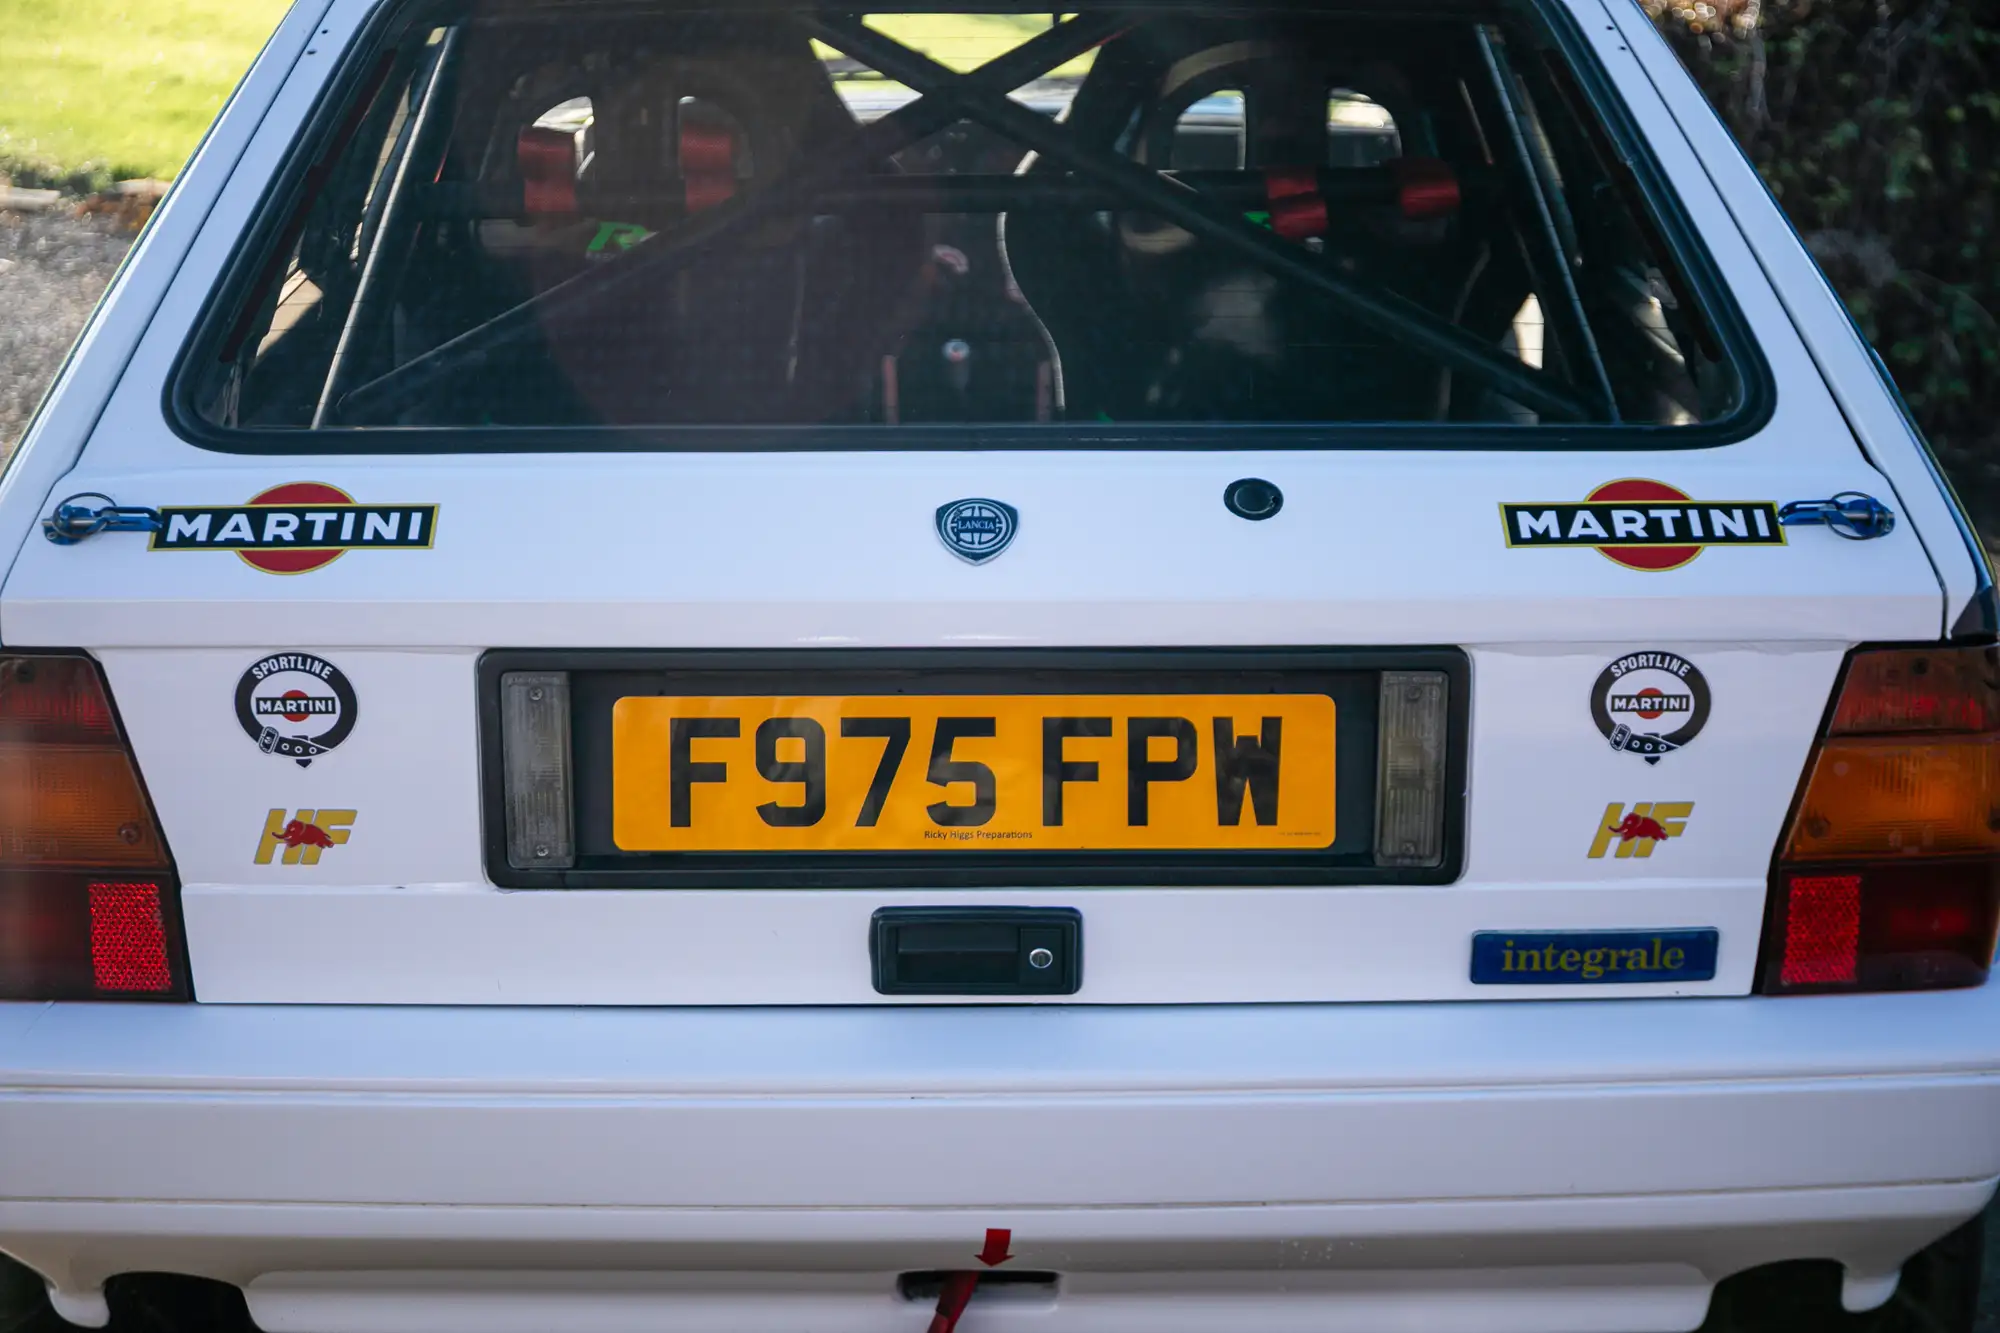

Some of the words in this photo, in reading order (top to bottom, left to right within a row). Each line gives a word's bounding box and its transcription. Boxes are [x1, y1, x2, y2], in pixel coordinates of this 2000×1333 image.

[166, 512, 423, 543] MARTINI
[958, 519, 995, 530] LANCIA
[1516, 508, 1771, 539] MARTINI
[252, 655, 334, 680] SPORTLINE
[1610, 653, 1691, 677] SPORTLINE
[259, 699, 334, 713] MARTINI
[1613, 697, 1688, 710] MARTINI
[669, 716, 996, 828] F975
[1041, 716, 1284, 827] FPW
[253, 808, 358, 865] HF
[924, 830, 948, 840] Ricky
[950, 830, 974, 840] Higgs
[976, 830, 1033, 840] Preparations
[1587, 801, 1695, 858] HF
[1501, 938, 1685, 979] integrale
